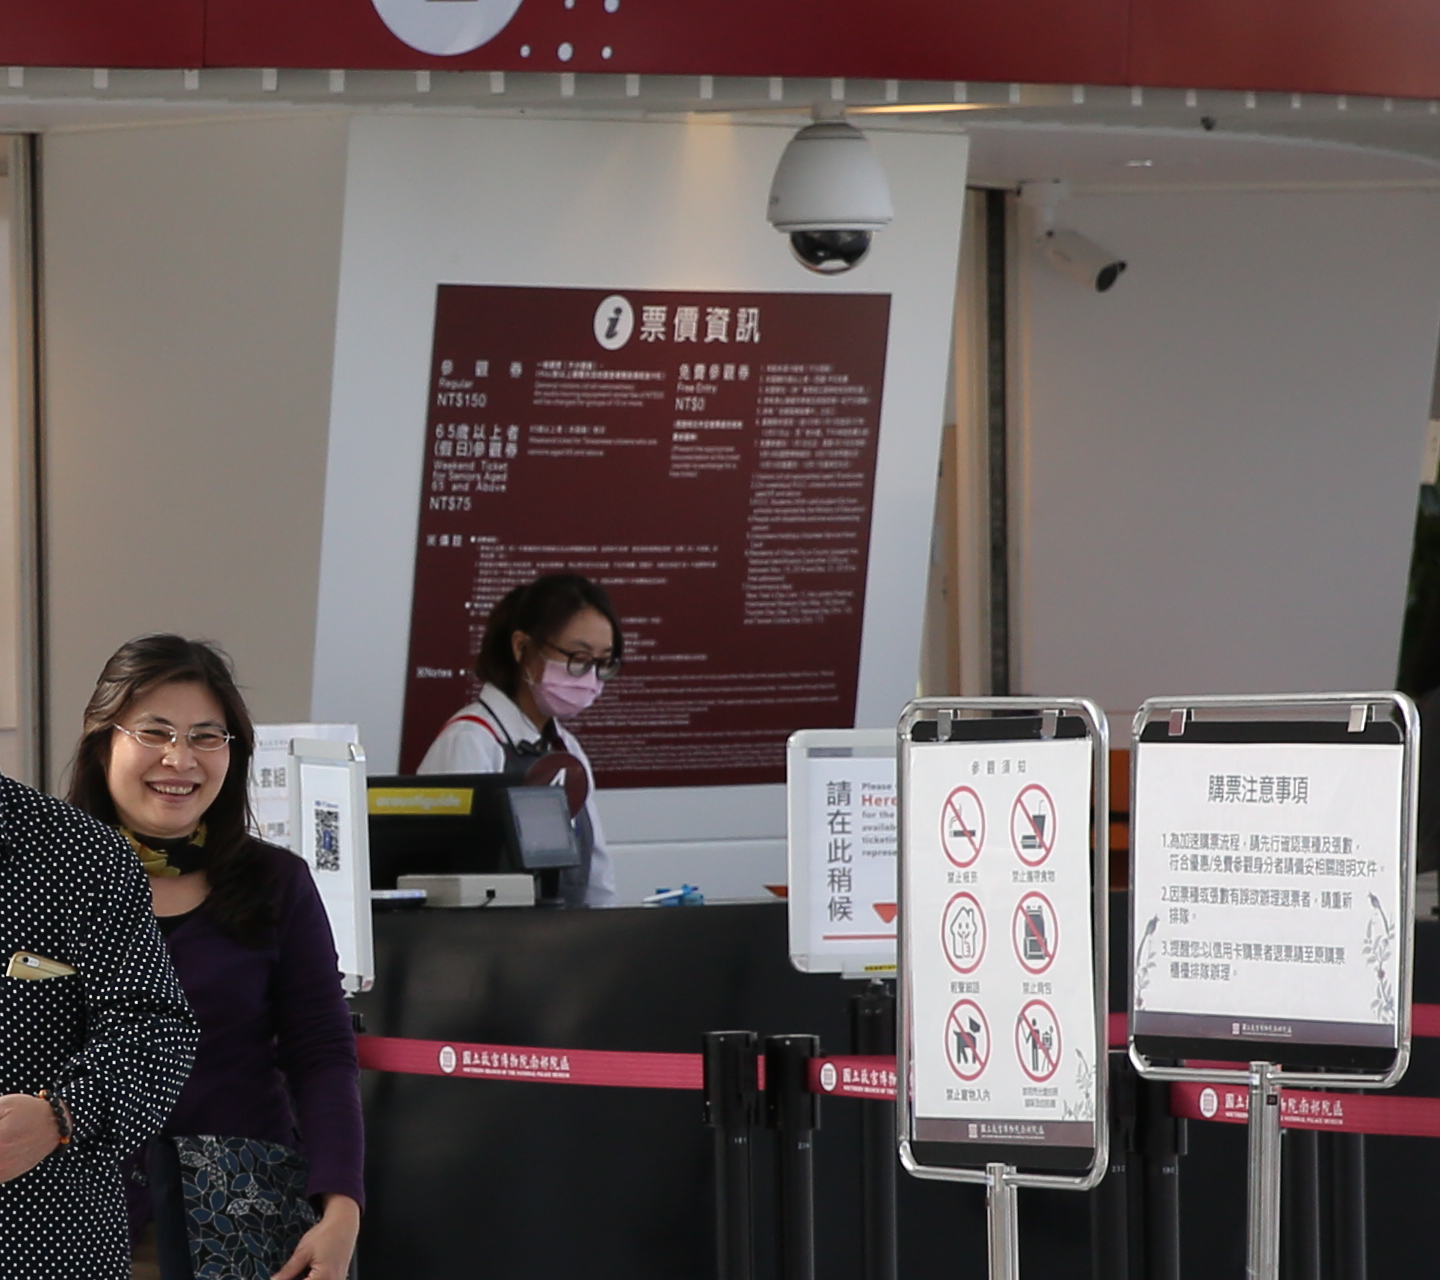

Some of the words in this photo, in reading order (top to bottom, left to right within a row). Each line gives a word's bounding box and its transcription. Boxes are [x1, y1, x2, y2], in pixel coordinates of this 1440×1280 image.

[639, 305, 762, 344] 票價資訊
[438, 377, 474, 390] Regular
[676, 382, 695, 392] Free
[695, 383, 718, 395] Entry
[436, 392, 488, 408] NT$150
[675, 396, 706, 412] NT$0
[428, 495, 472, 511] NT$75
[971, 759, 1027, 776] 參觀須知
[861, 782, 892, 791] Please
[1207, 774, 1309, 806] 購票注意事項
[862, 810, 876, 818] for
[879, 810, 895, 818] the
[826, 780, 853, 923] 請在此稍候
[462, 1050, 571, 1071] 國立故宮博物院南部院區
